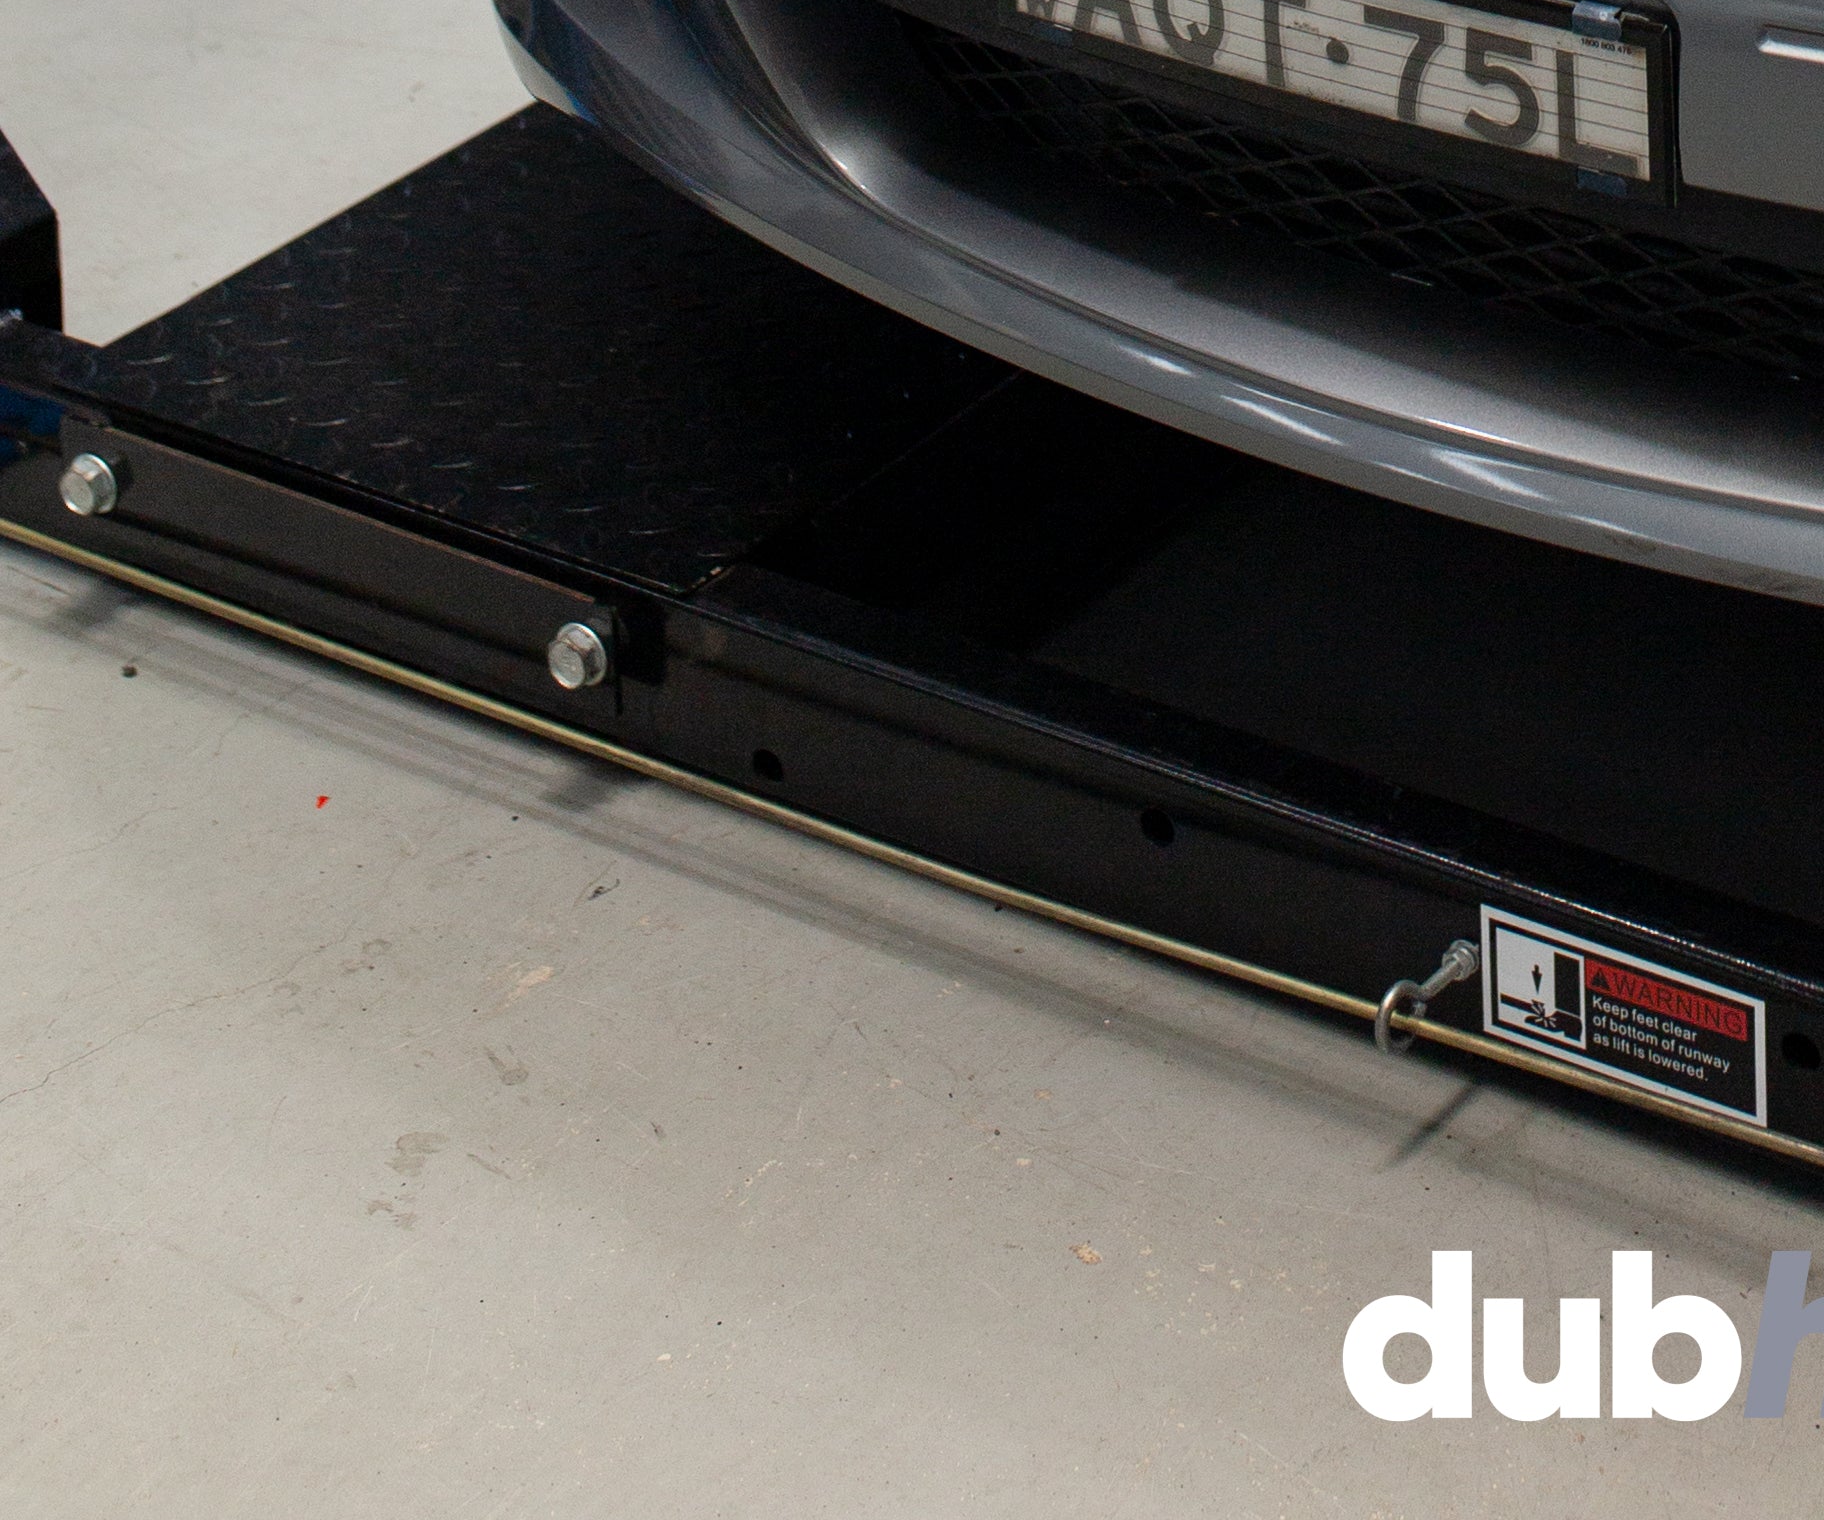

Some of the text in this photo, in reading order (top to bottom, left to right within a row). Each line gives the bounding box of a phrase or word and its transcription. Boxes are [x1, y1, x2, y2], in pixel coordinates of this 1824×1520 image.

[1592, 995, 1697, 1042] Keep feet clear
[1613, 972, 1742, 1034] WARNING
[1592, 1015, 1731, 1074] of bottom of runway
[1593, 1032, 1709, 1081] as lift is lowered.
